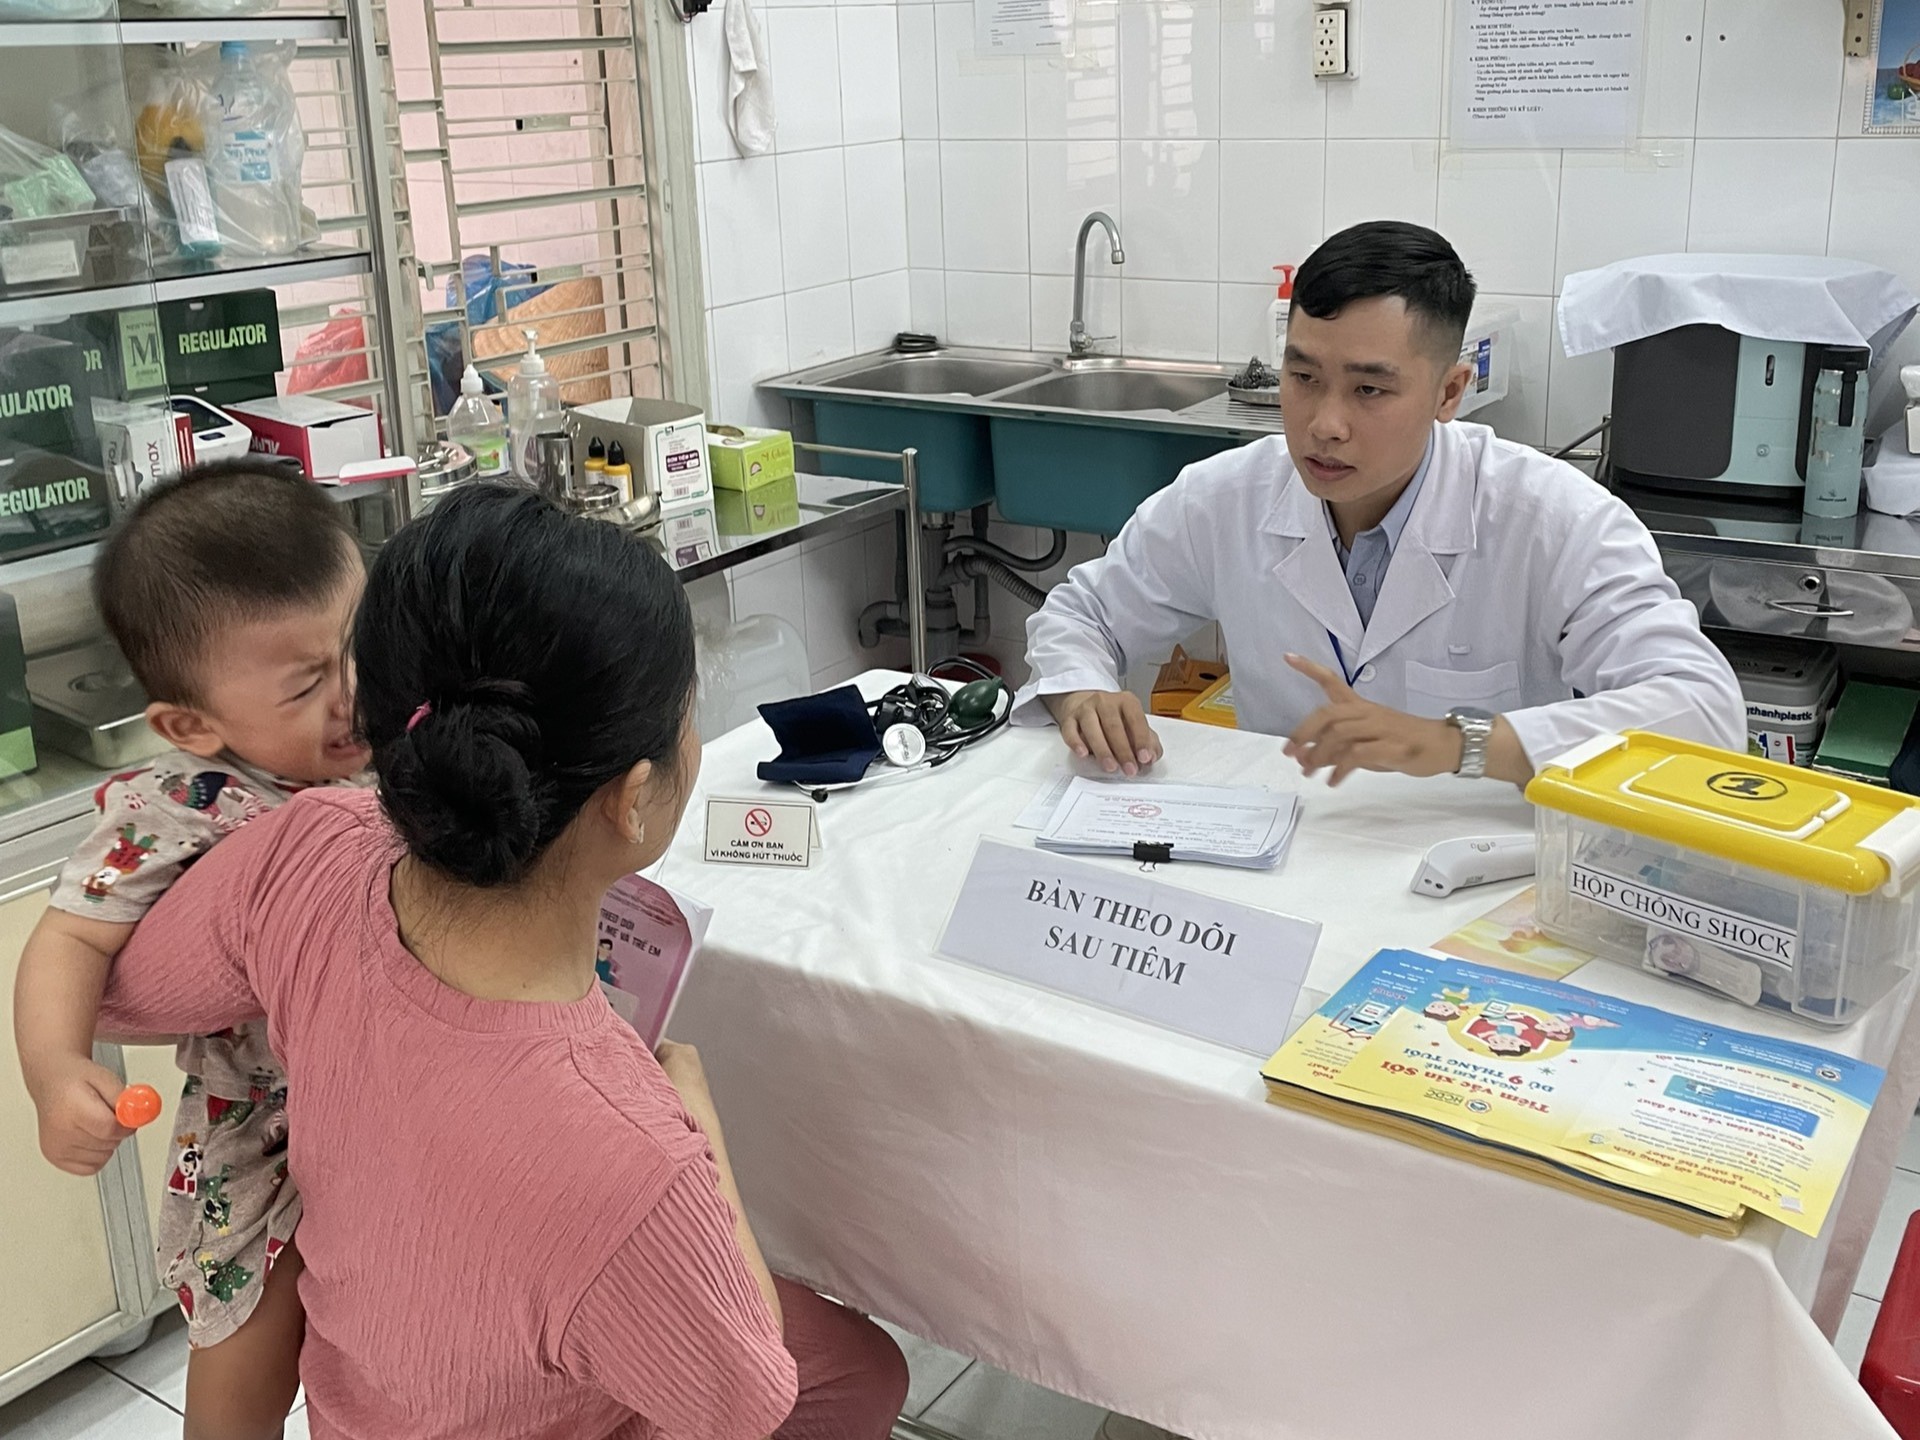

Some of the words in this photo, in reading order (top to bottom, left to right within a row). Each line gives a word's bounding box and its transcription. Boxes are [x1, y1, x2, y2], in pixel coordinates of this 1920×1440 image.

[178, 323, 268, 355] REGULATOR
[84, 349, 103, 373] R
[720, 849, 751, 859] KHÔNG
[1025, 879, 1086, 914] BÀN
[1091, 896, 1173, 938] THEO
[1177, 921, 1239, 956] DÕI
[1572, 871, 1615, 899] HỘP
[1620, 889, 1701, 930] CHỐNG
[1707, 917, 1791, 959] SHOCK
[1044, 925, 1103, 960] SAU
[1111, 942, 1188, 986] TIÊM
[1423, 1070, 1456, 1085] xin
[1508, 1074, 1524, 1085] 9
[1499, 1091, 1550, 1114] Tiêm
